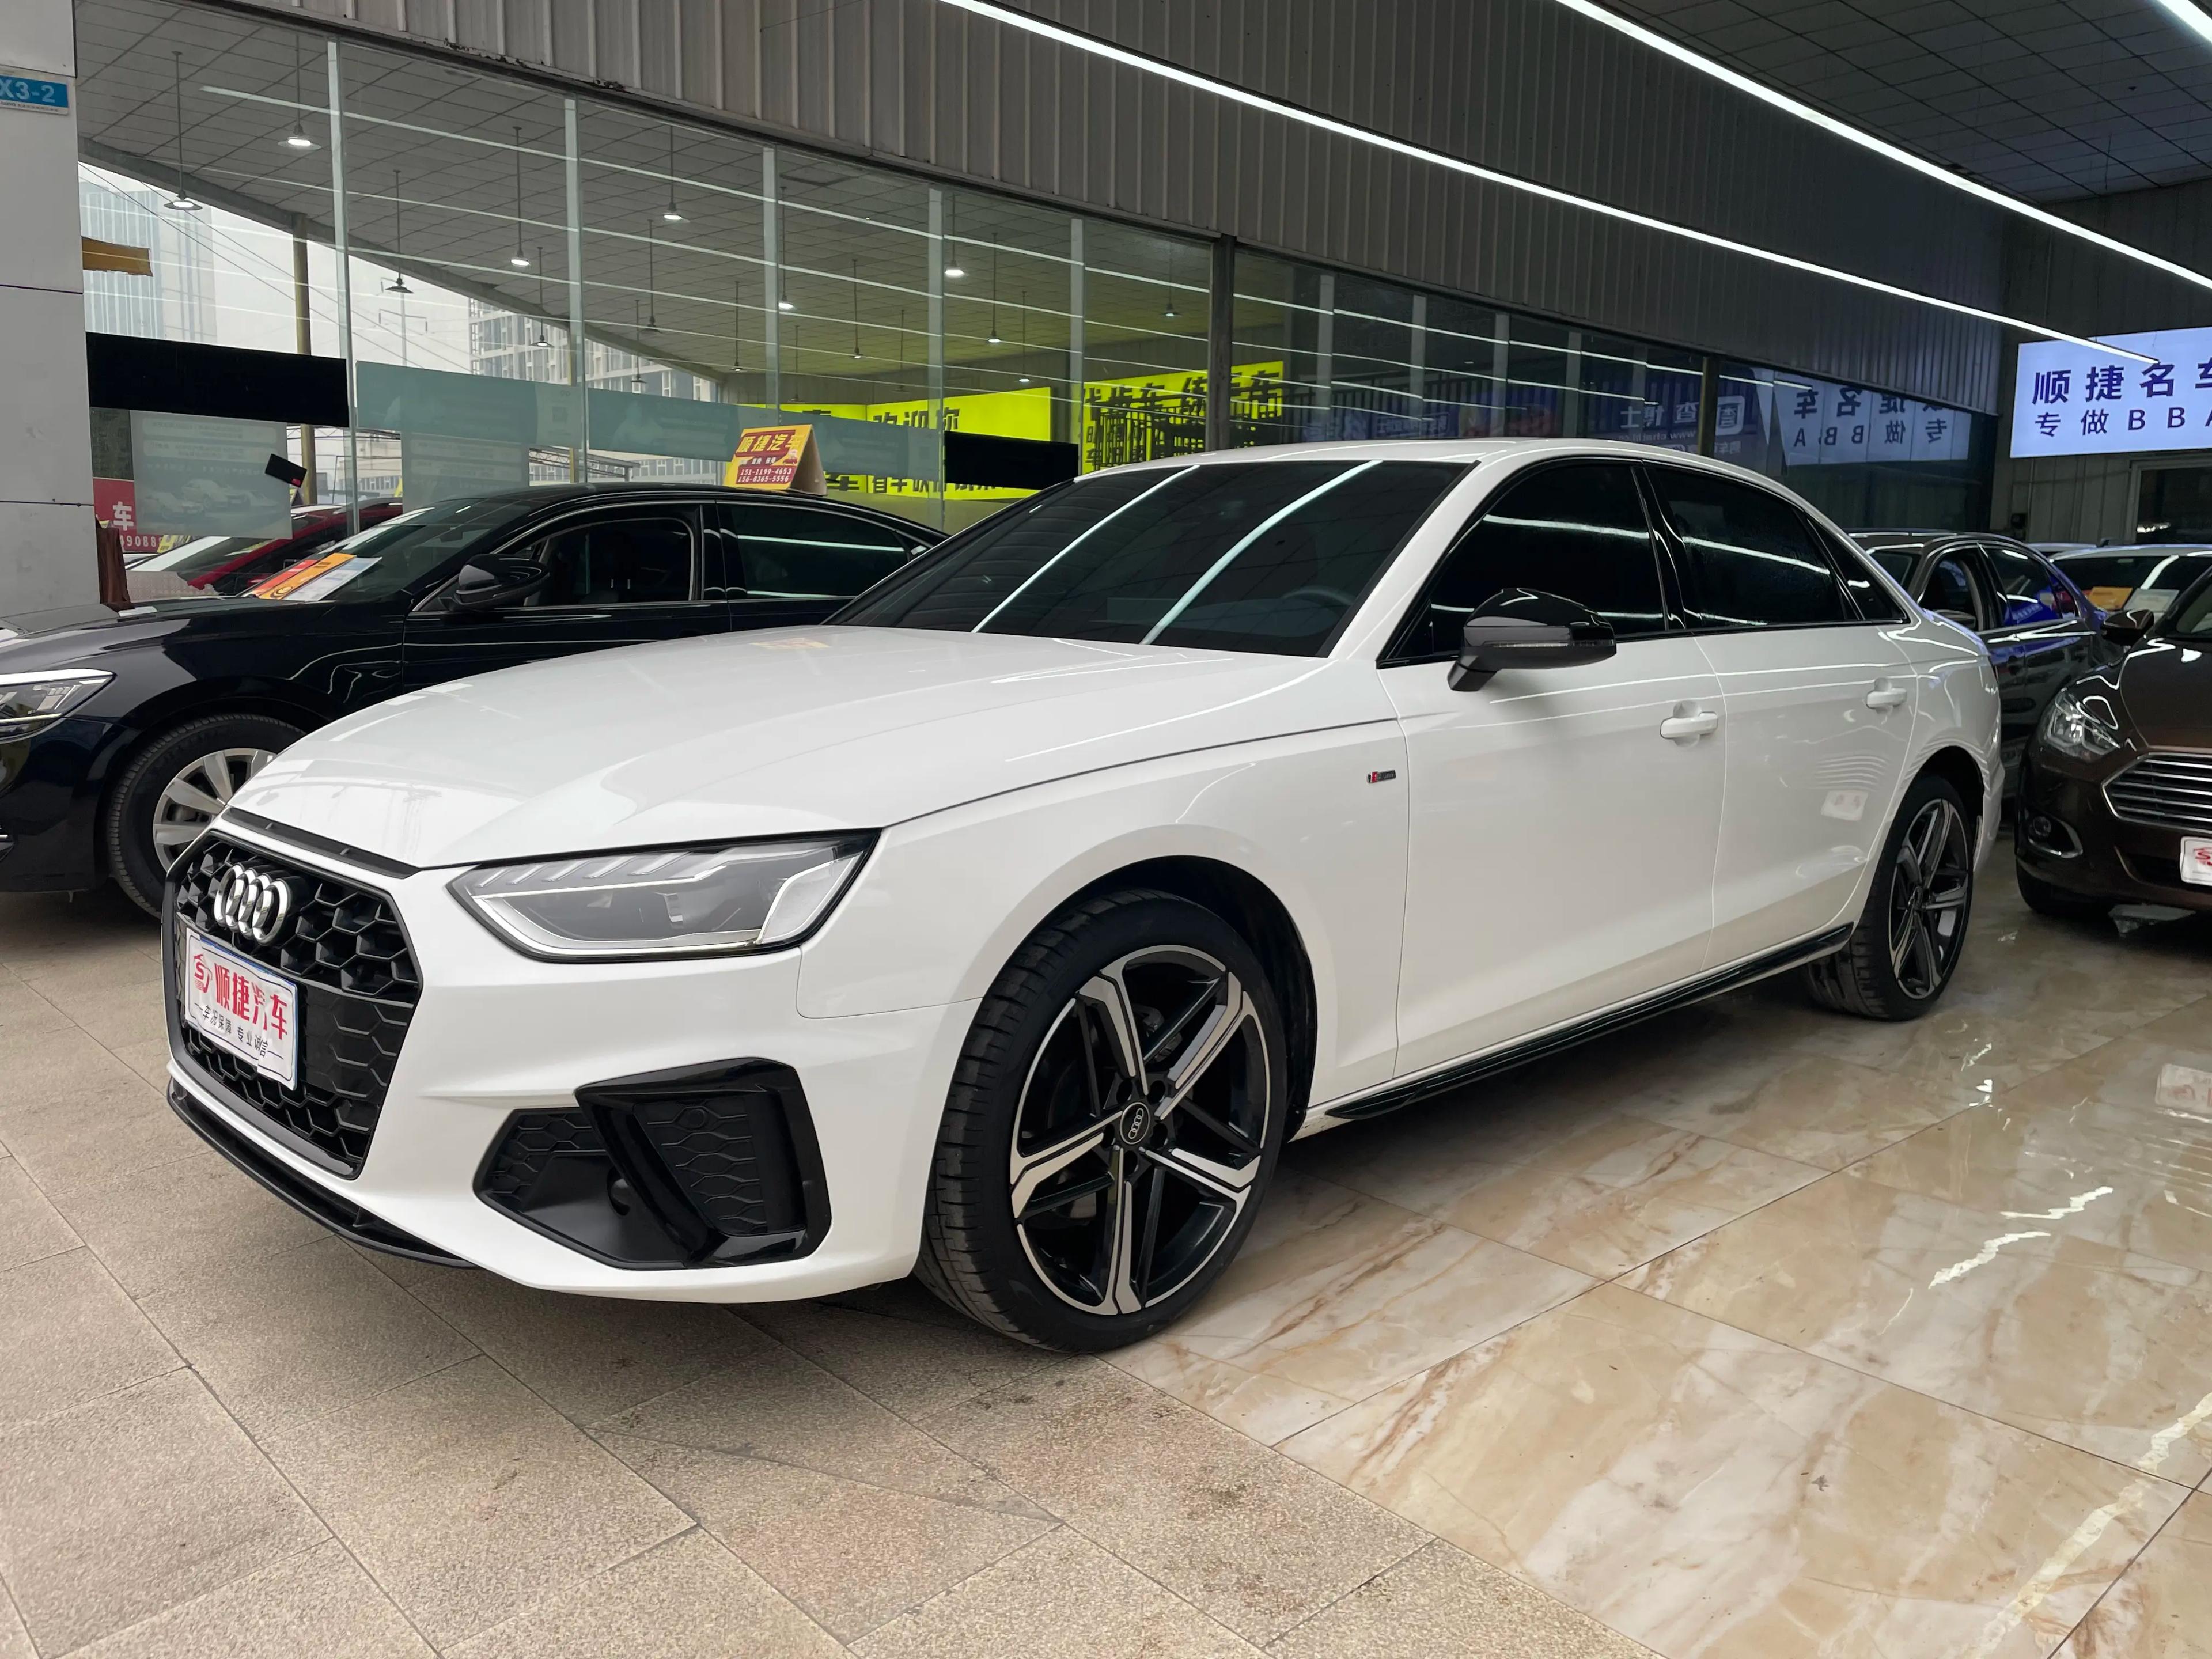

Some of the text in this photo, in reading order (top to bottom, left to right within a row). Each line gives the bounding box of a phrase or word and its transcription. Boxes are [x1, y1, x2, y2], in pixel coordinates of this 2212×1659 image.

[113, 501, 134, 531] 车
[120, 535, 162, 547] 9088
[214, 963, 287, 1040] 顺捷汽车
